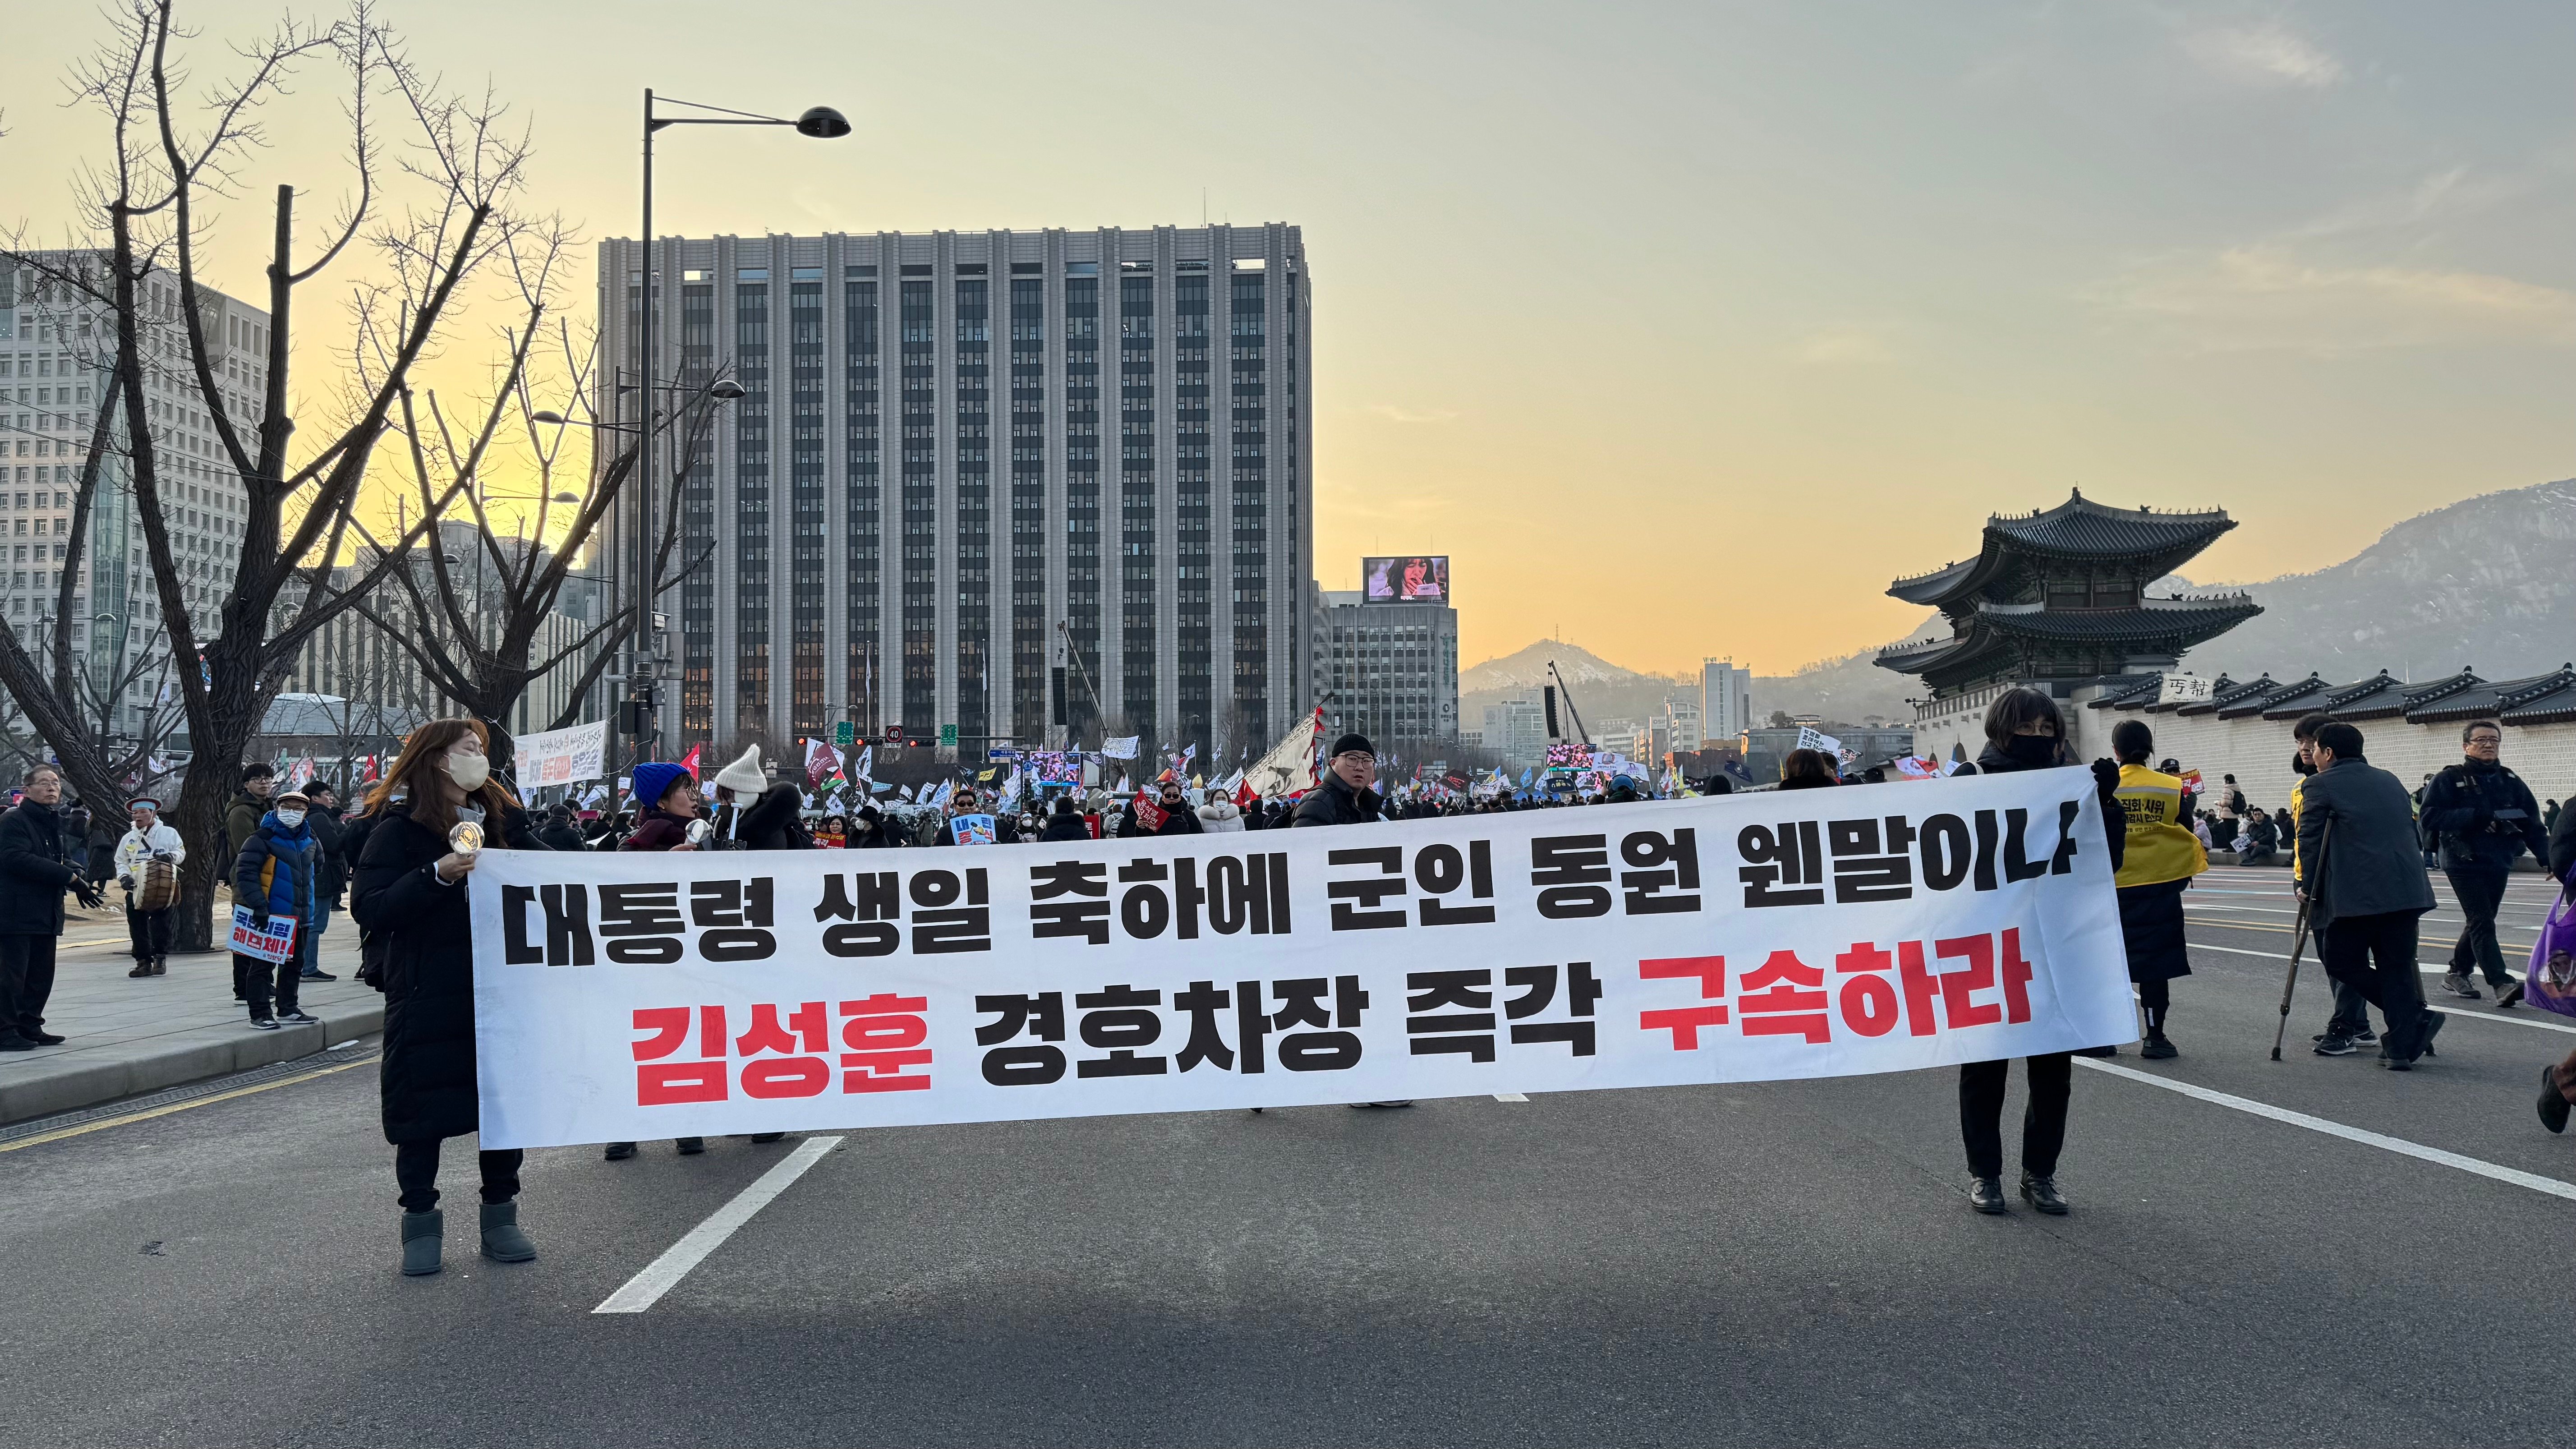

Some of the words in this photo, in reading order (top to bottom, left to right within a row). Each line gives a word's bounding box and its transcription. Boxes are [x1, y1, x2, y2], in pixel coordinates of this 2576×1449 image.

[502, 877, 776, 966] 대통령
[814, 868, 991, 957] 생일
[1030, 852, 1291, 944] 축하에
[1328, 840, 1495, 931] 군인
[1532, 828, 1701, 919] 동원
[632, 994, 932, 1105] 김성훈
[975, 975, 1369, 1086] 경호차장
[1407, 962, 1602, 1063] 즉각
[1639, 928, 2032, 1050] 구속하라
